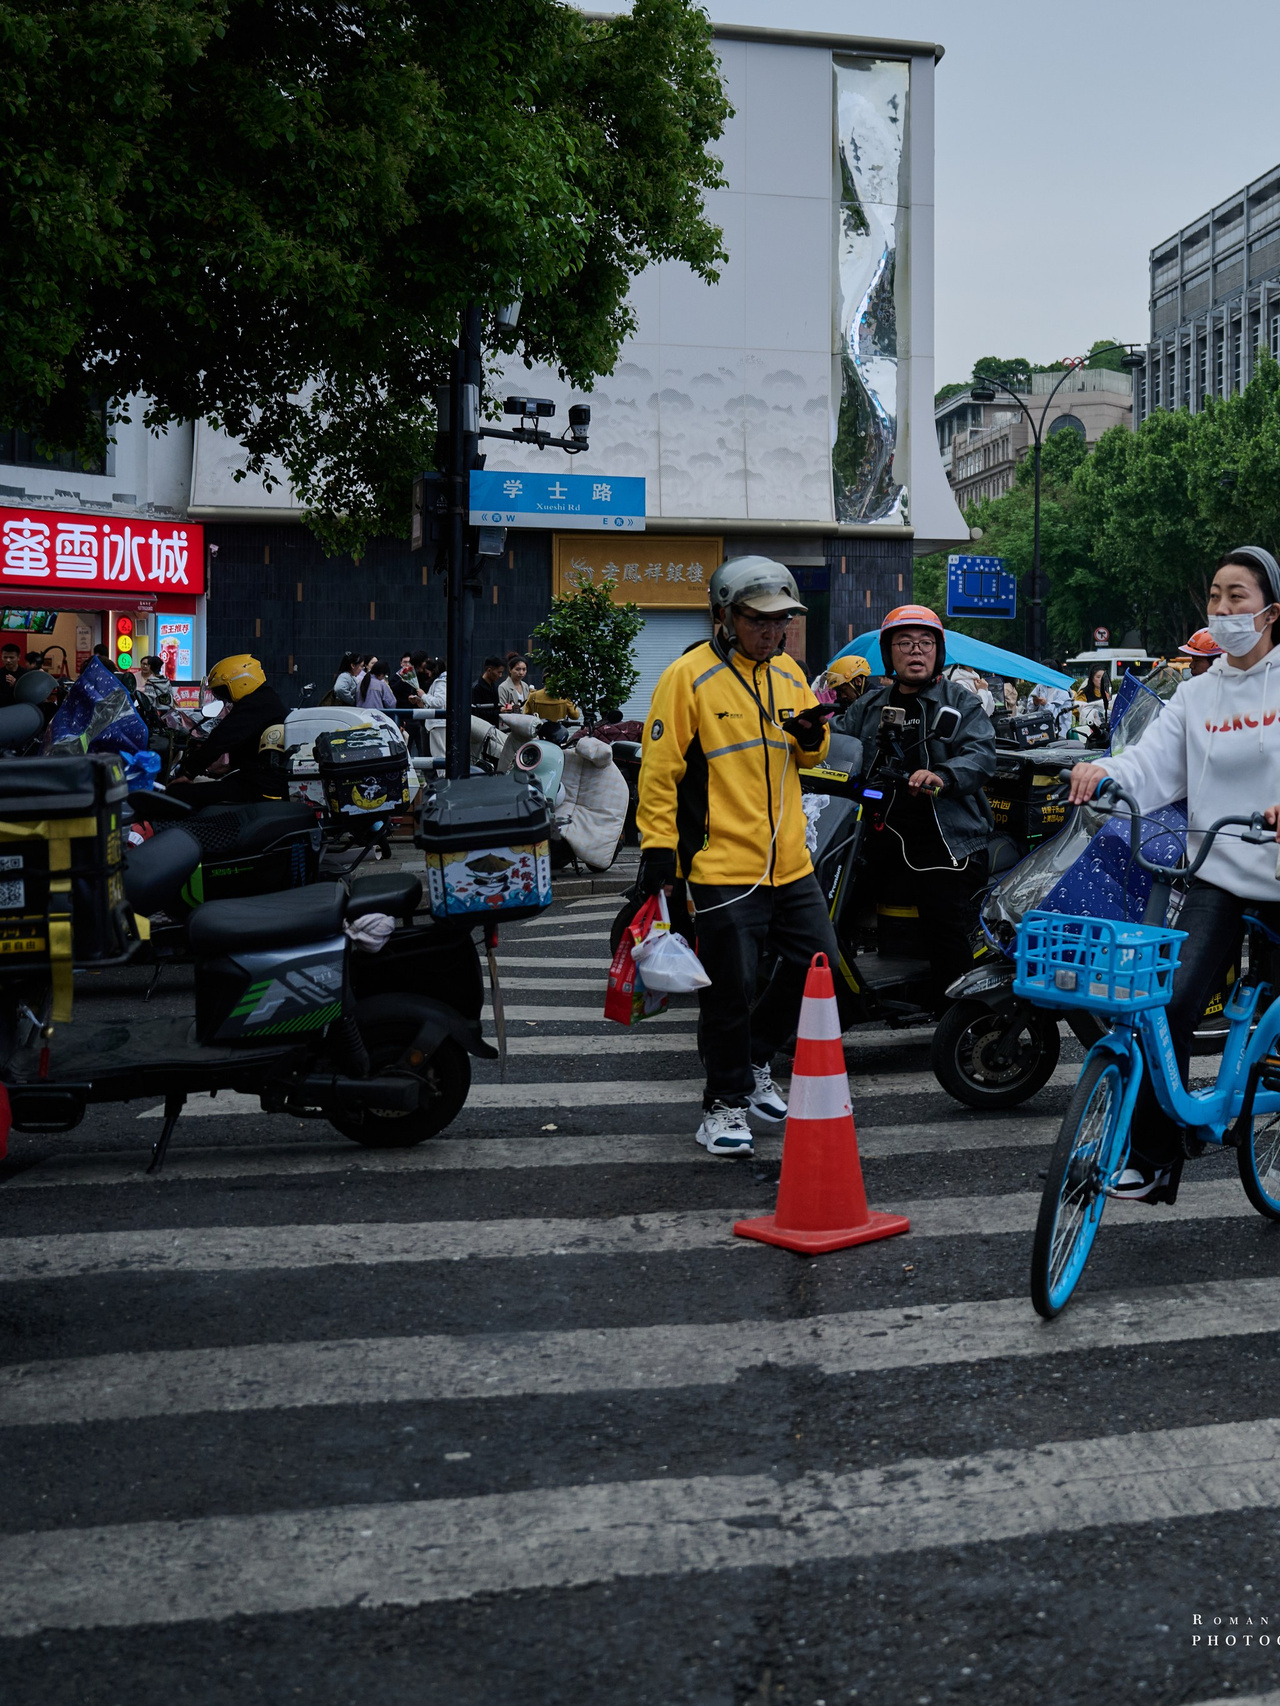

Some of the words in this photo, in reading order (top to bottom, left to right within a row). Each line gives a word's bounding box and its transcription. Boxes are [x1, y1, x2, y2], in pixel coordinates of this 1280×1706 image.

[503, 480, 613, 502] 学士路
[536, 503, 566, 511] Xueshi
[2, 517, 190, 586] 蜜雪冰城
[828, 864, 842, 900] Premium
